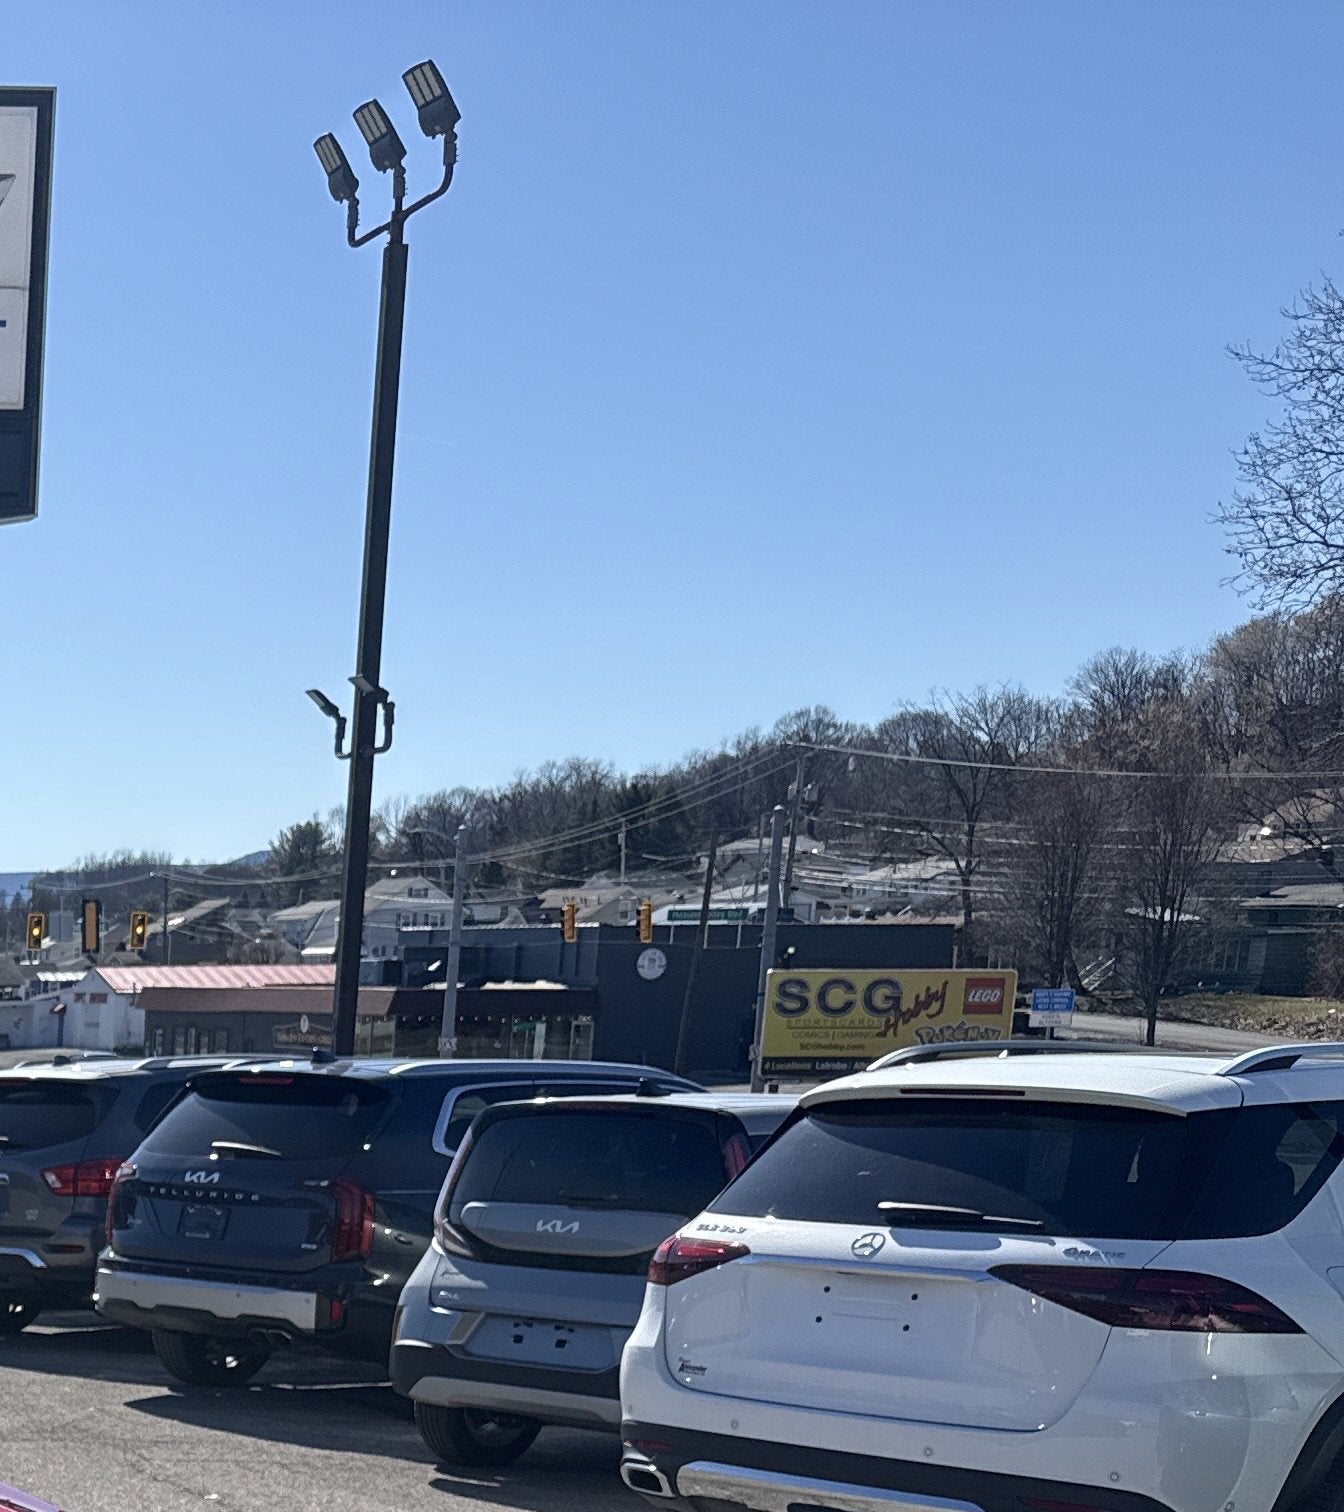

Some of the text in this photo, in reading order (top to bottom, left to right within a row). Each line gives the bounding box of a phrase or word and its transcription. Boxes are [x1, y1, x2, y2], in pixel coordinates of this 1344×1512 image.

[773, 977, 903, 1018] SCG
[968, 988, 1001, 1003] LEGO
[150, 1186, 259, 1201] TELLURIDE
